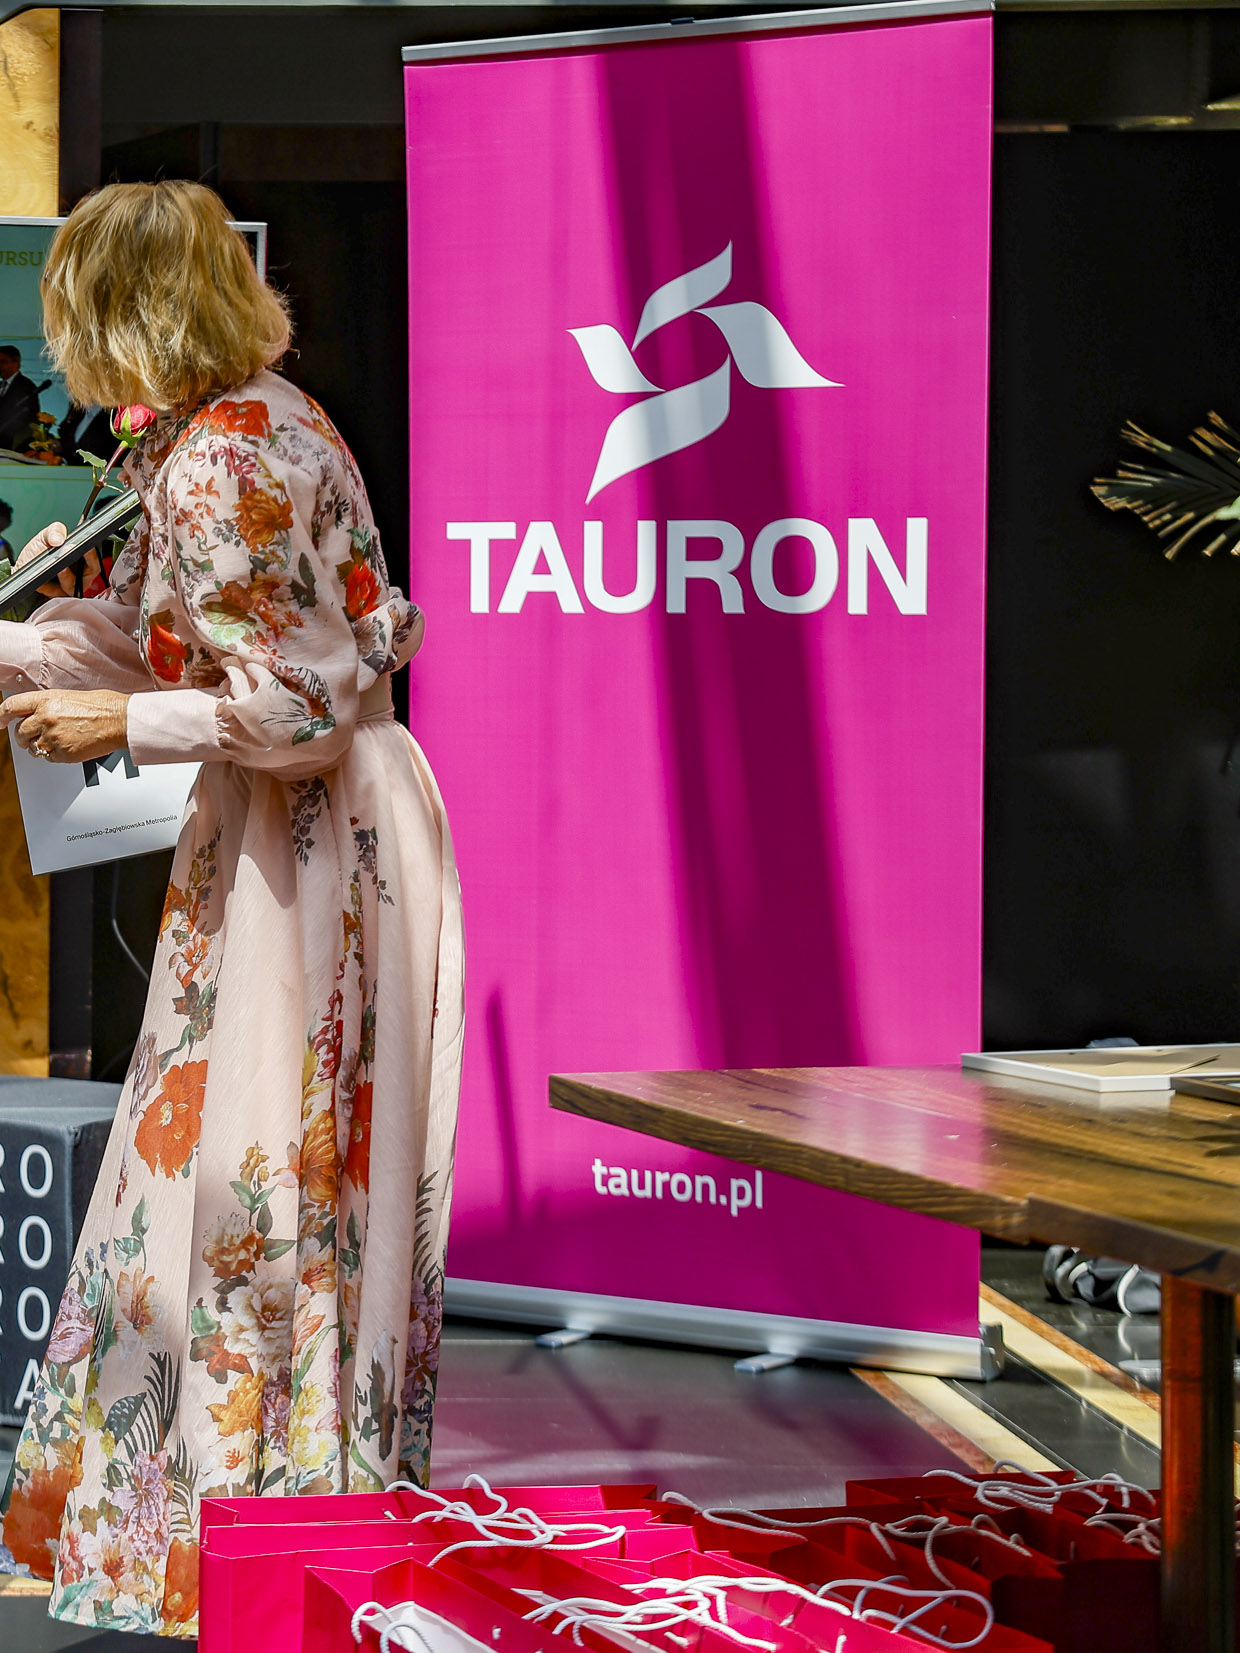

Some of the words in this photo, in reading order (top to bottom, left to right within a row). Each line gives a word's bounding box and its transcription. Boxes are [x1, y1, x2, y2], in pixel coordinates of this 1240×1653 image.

[446, 517, 928, 615] TAURON
[145, 814, 178, 826] Metropolia
[592, 1158, 763, 1217] tauron.pl
